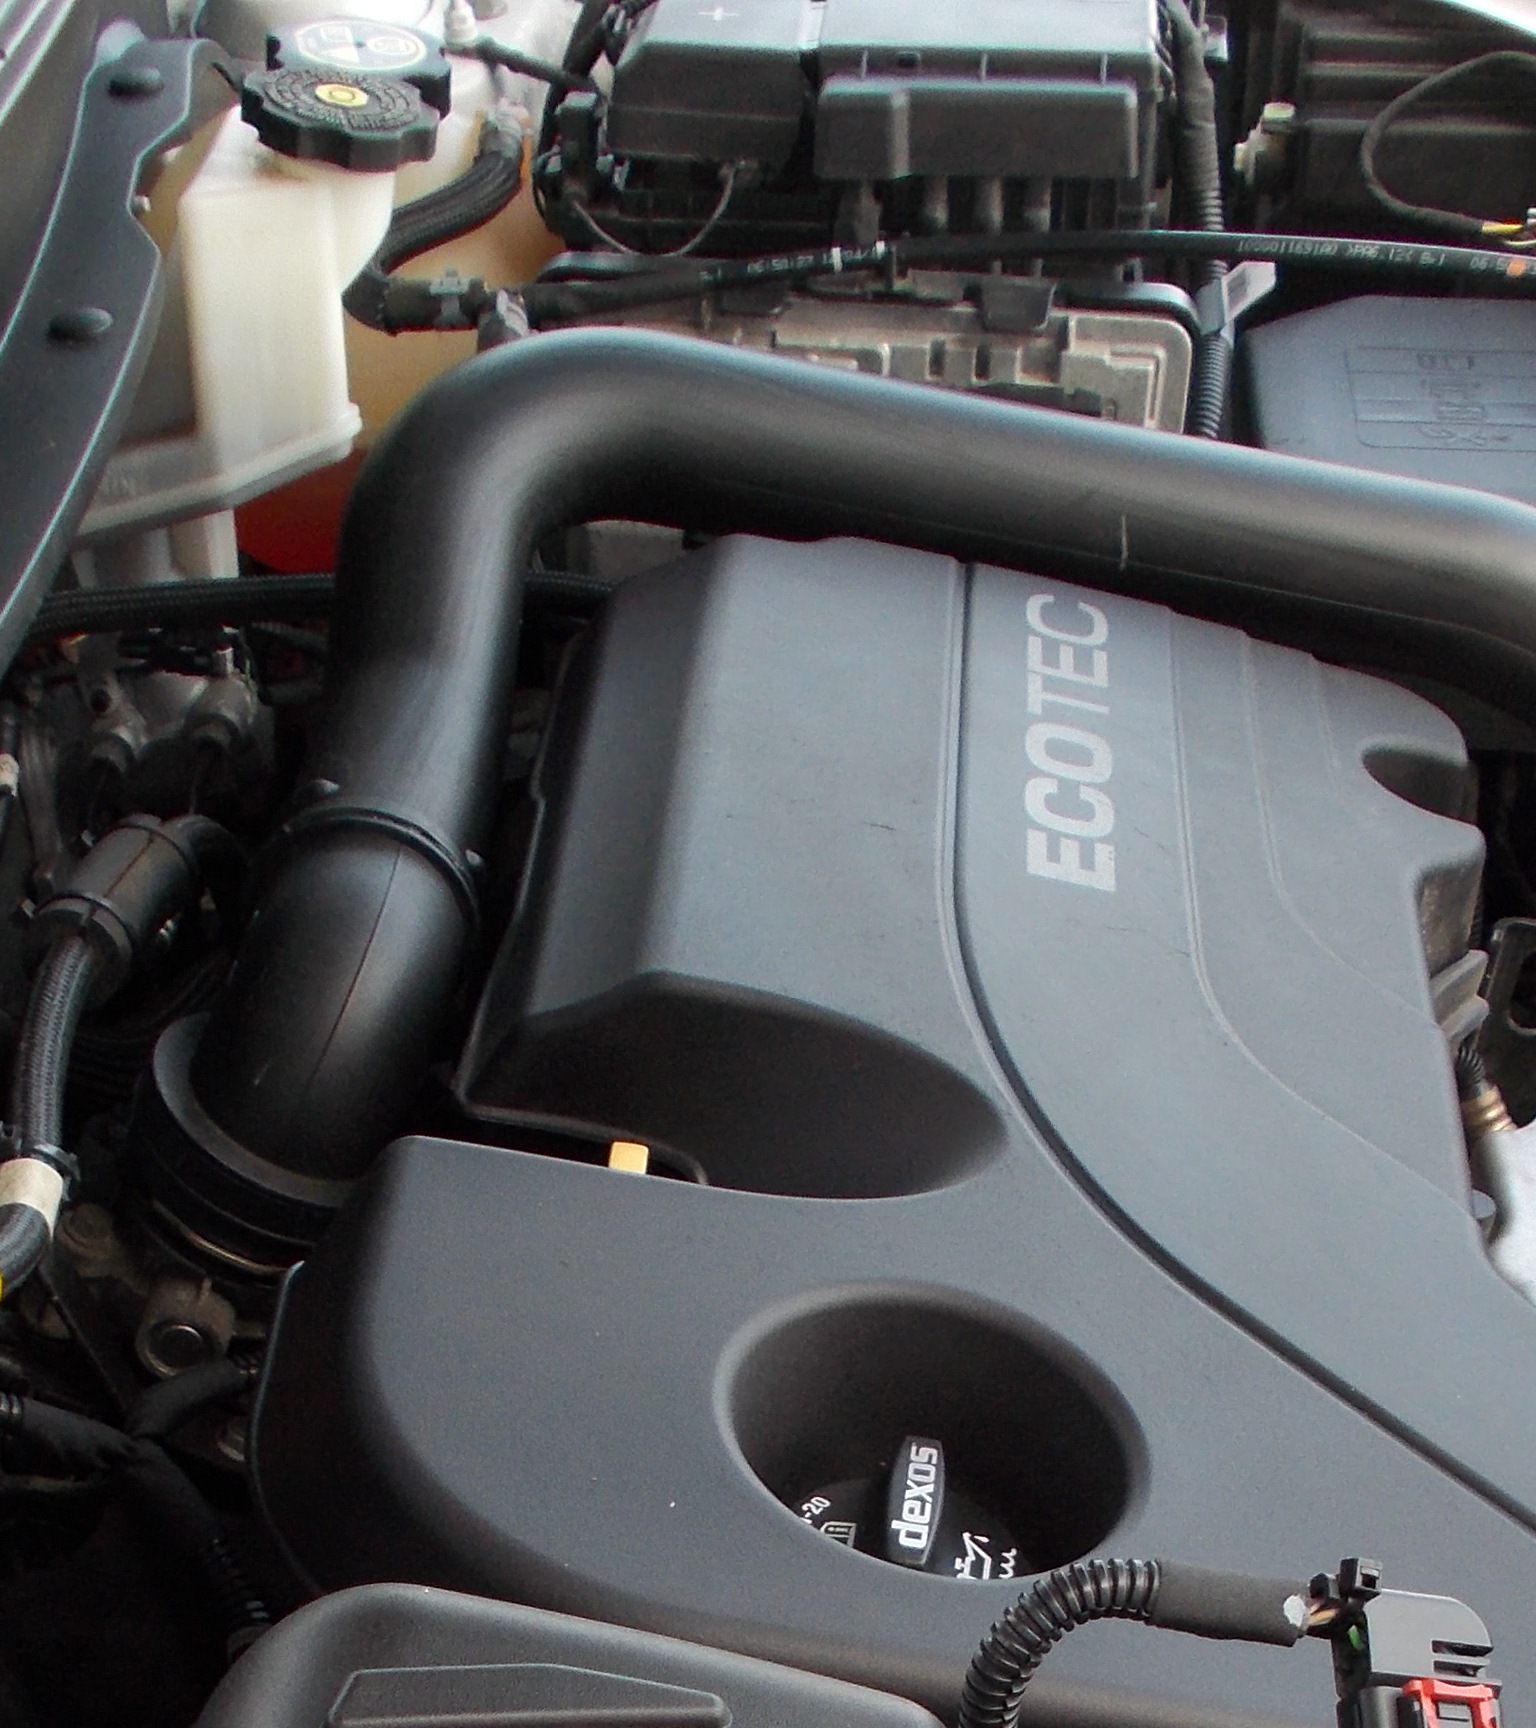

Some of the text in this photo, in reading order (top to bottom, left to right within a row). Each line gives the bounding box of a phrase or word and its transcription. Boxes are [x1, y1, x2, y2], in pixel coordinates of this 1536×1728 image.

[1025, 593, 1116, 892] ECOTEC
[800, 1495, 832, 1525] -20
[890, 1442, 939, 1549] dexos
